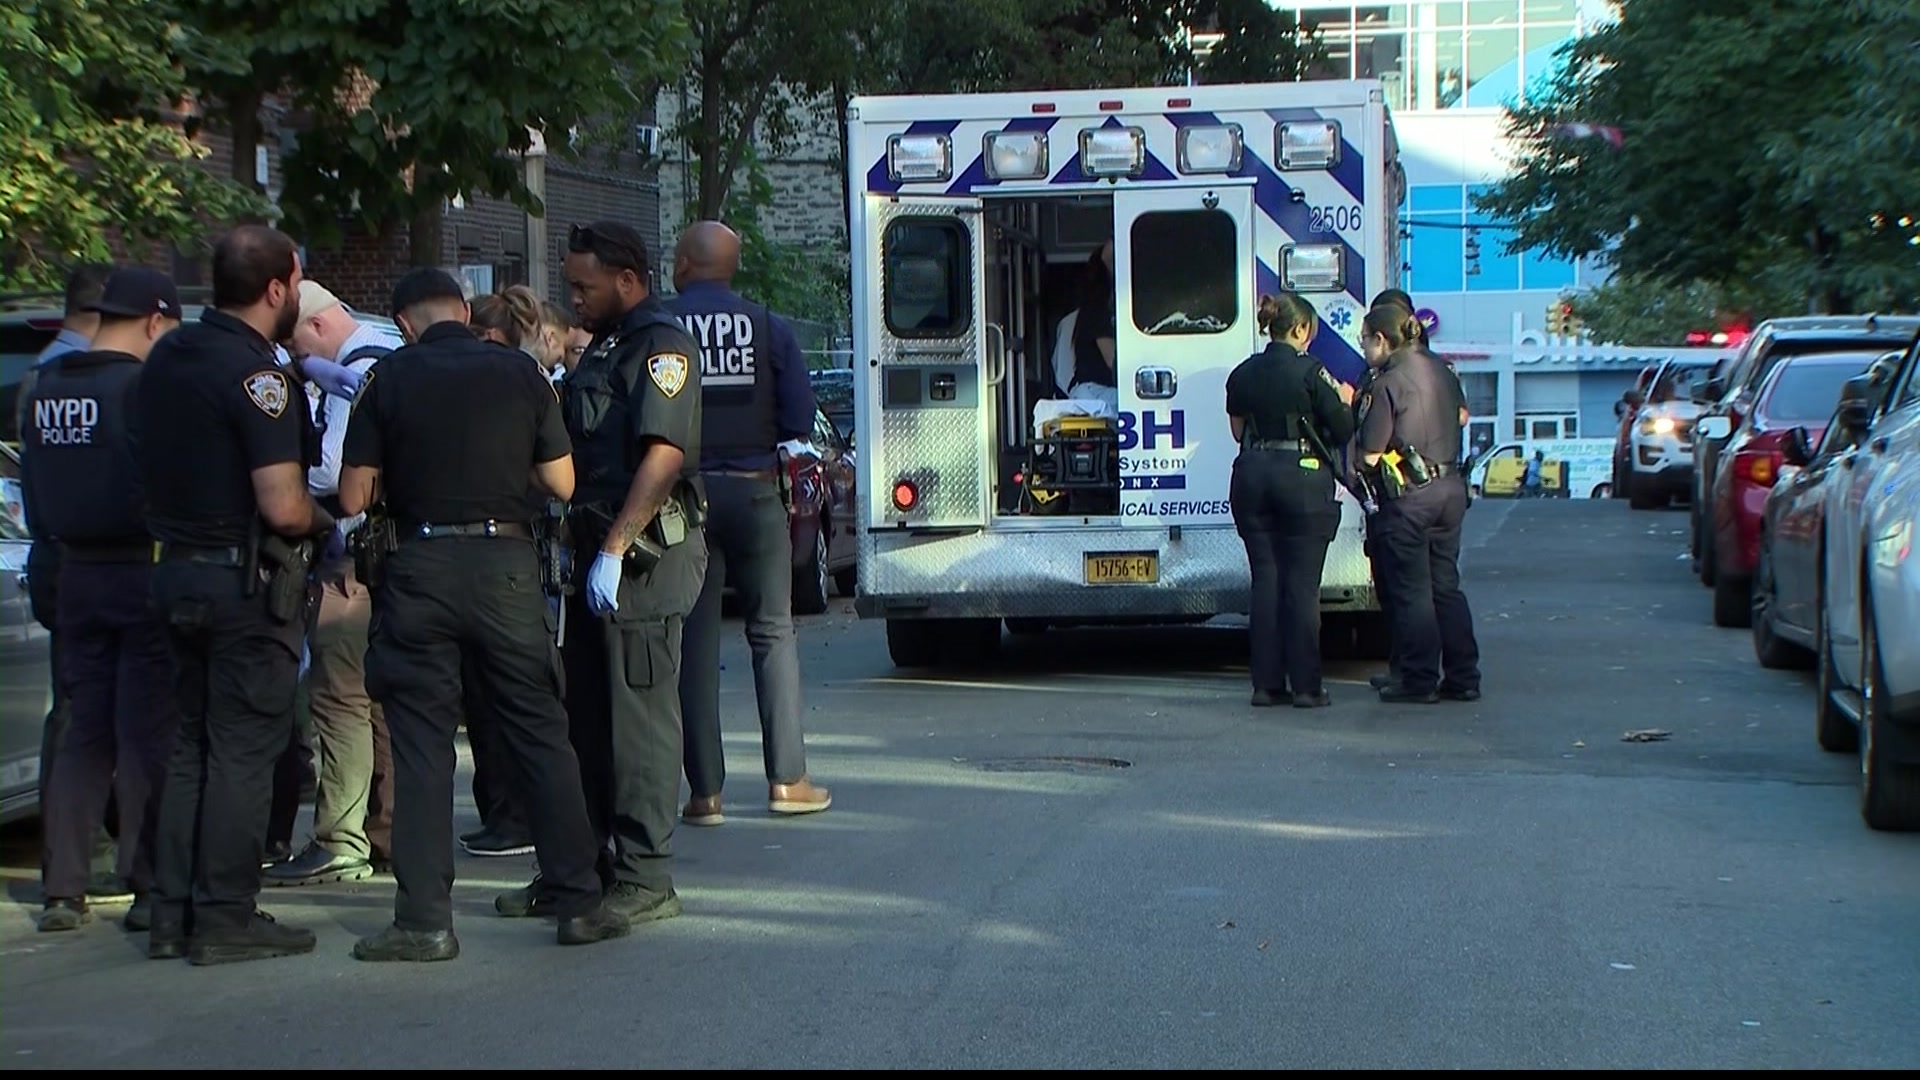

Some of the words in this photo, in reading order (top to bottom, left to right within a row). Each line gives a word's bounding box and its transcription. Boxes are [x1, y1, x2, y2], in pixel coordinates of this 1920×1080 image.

[1309, 205, 1362, 232] 2506
[1512, 312, 1652, 365] bli
[699, 347, 755, 375] LICE
[35, 398, 99, 429] NYPD
[42, 426, 92, 445] POLICE
[1119, 457, 1186, 473] System
[1159, 501, 1230, 515] SERVICES
